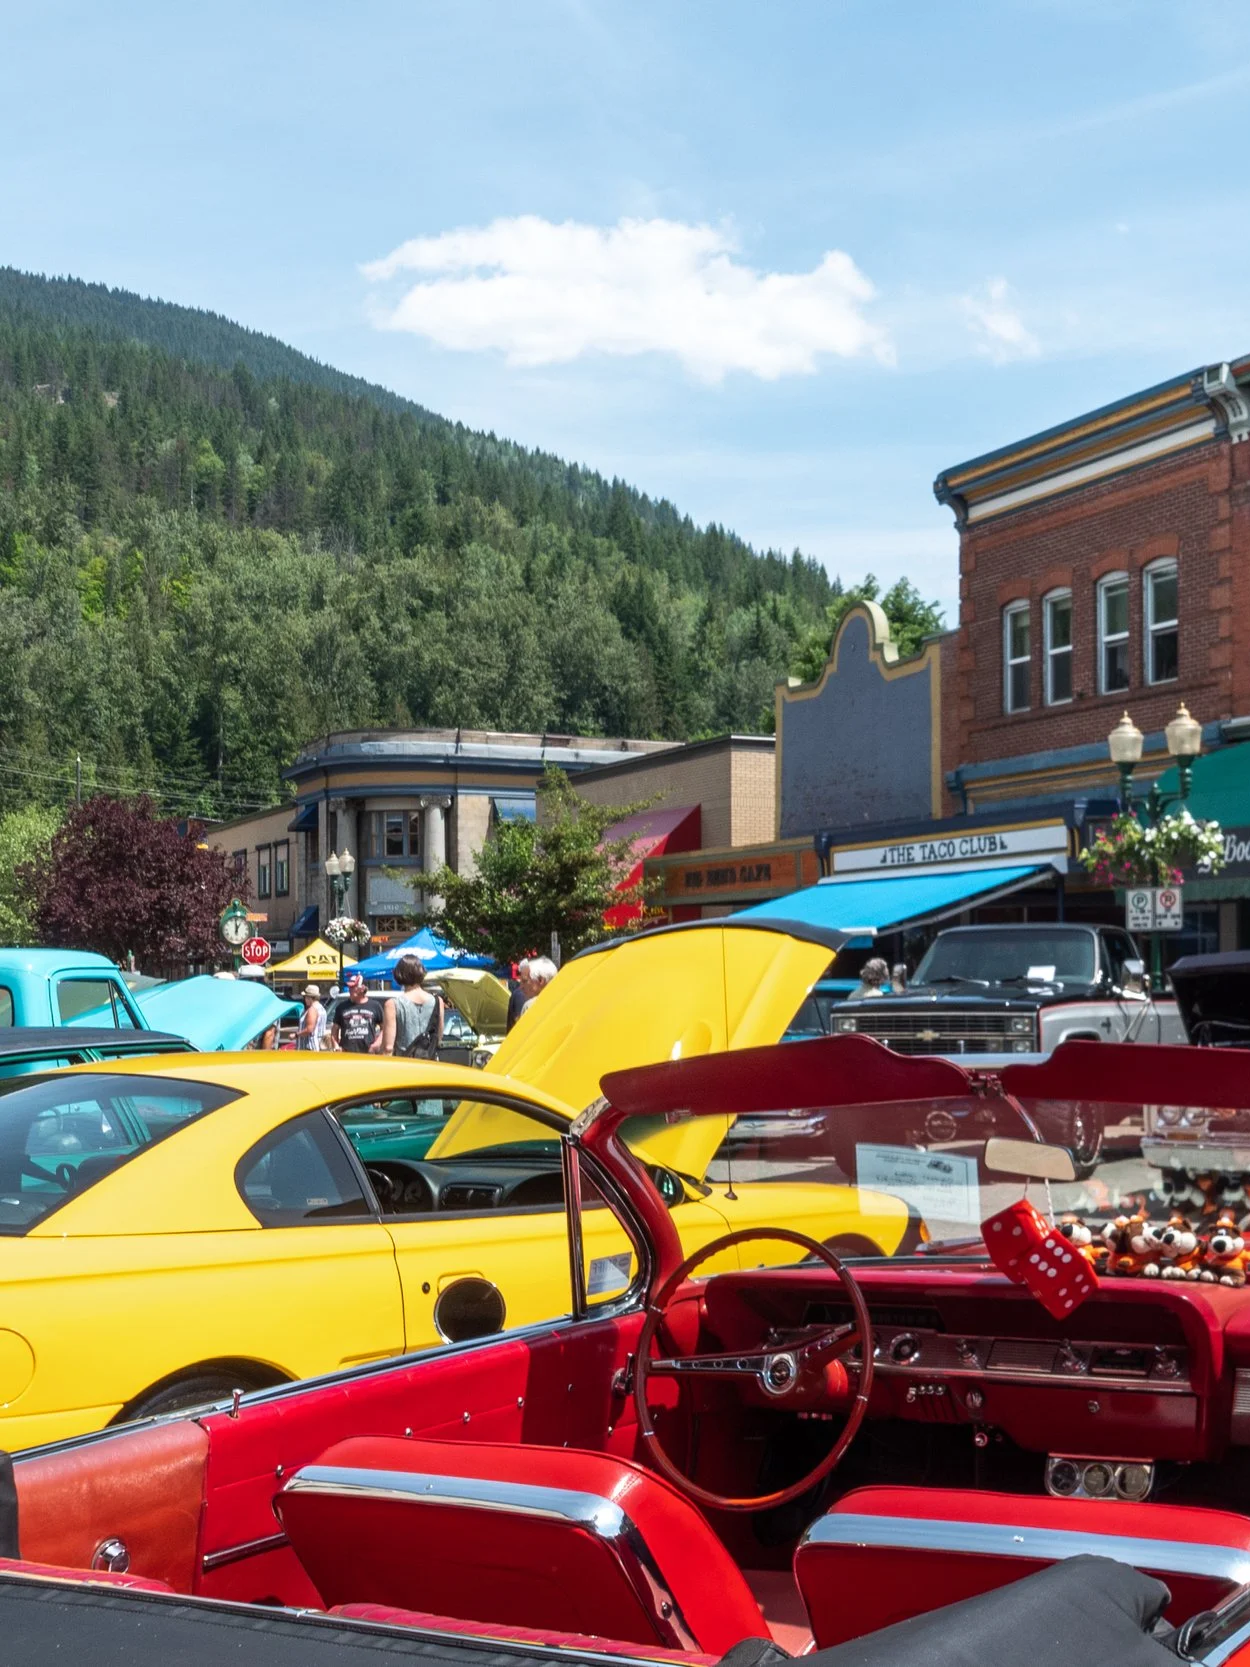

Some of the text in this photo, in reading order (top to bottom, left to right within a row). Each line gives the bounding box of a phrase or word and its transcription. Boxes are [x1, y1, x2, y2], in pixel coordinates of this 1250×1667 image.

[888, 836, 998, 863] THE TACO CLUB
[244, 944, 269, 957] STOP
[306, 954, 338, 965] CAT
